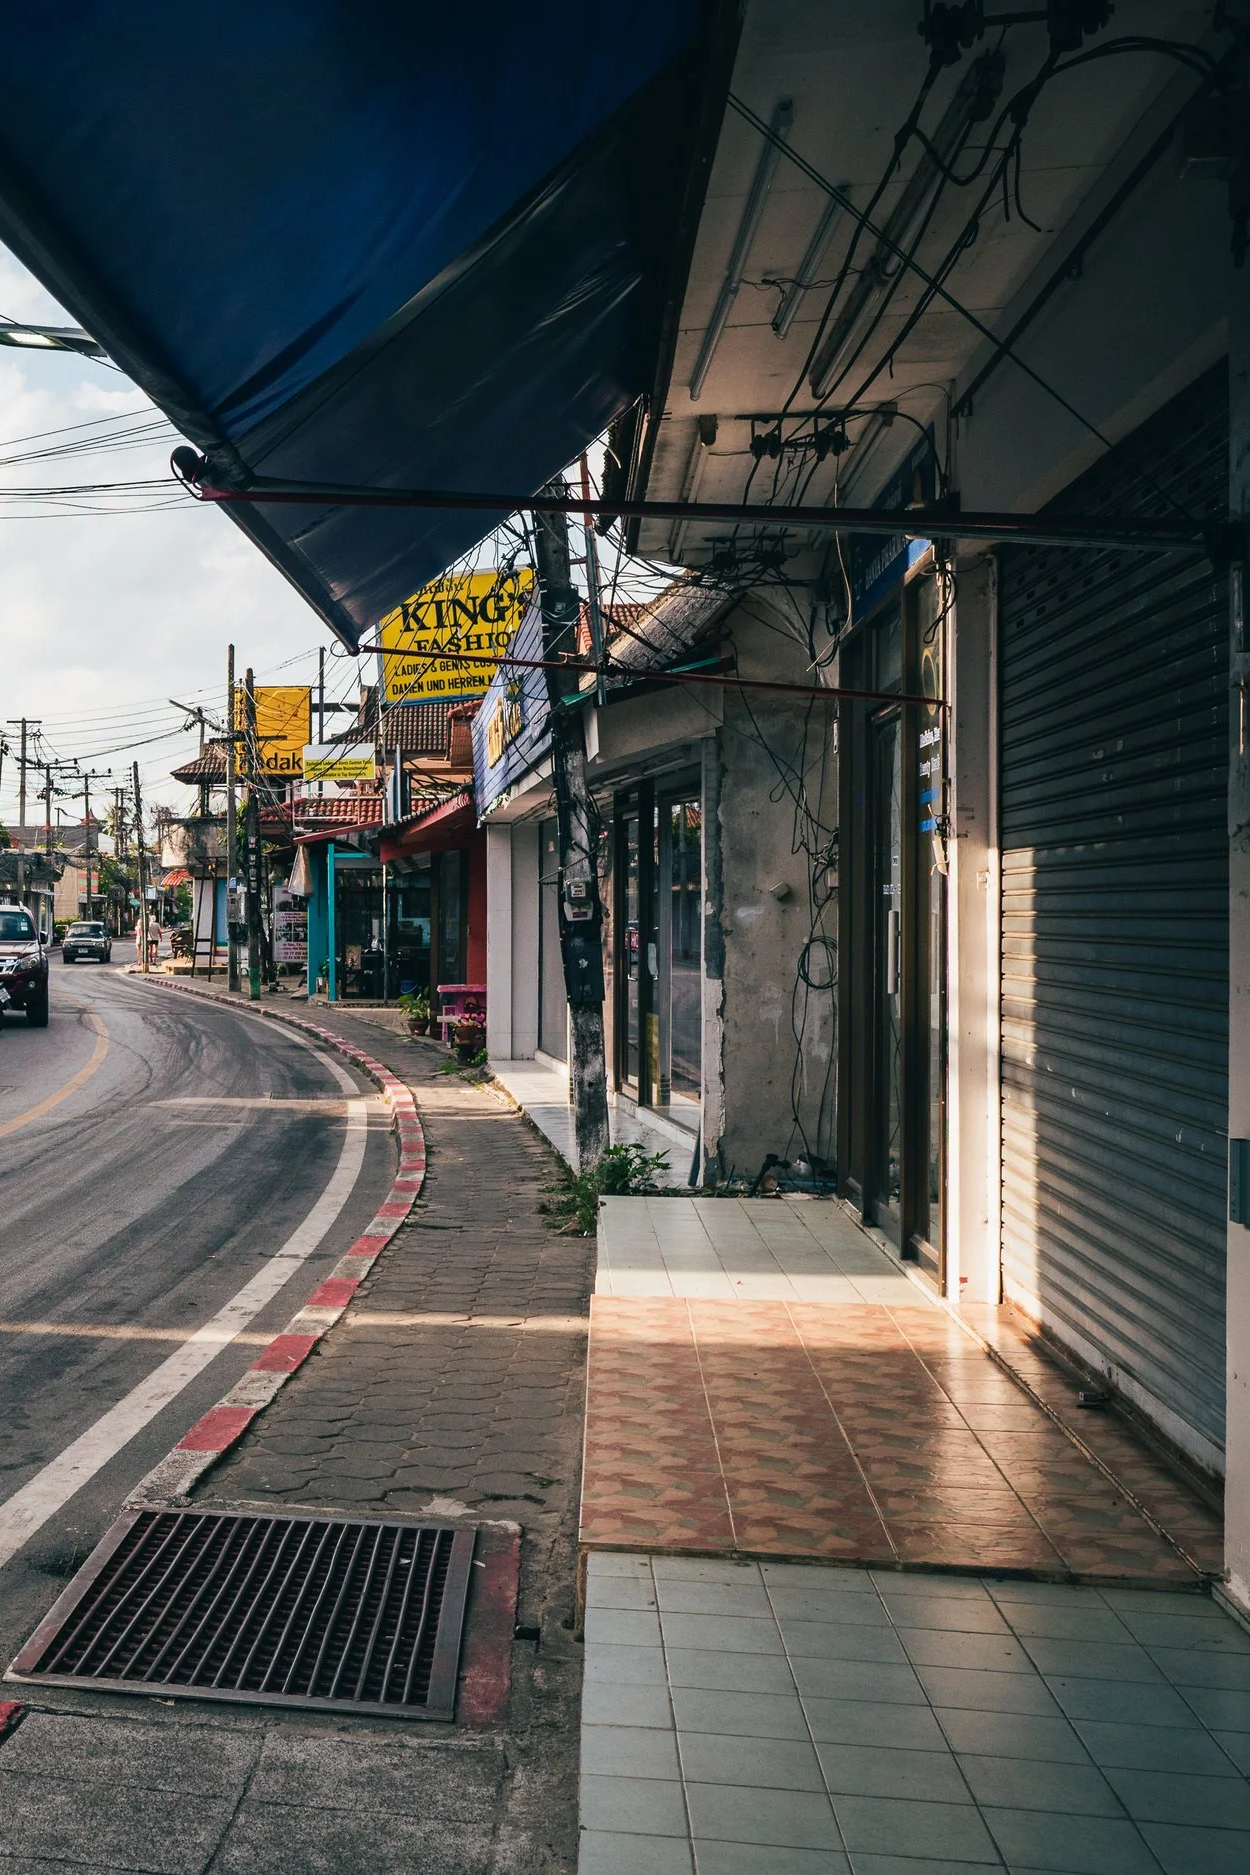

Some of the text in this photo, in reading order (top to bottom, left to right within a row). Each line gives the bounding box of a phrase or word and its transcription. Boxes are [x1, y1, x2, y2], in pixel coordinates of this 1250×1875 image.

[414, 631, 514, 654] FASHIO
[394, 662, 427, 677] LADIES
[431, 661, 437, 672] &
[440, 659, 471, 672] GENTS
[392, 682, 424, 695] DAMEN
[427, 680, 445, 691] UND
[448, 675, 485, 689] HERREN
